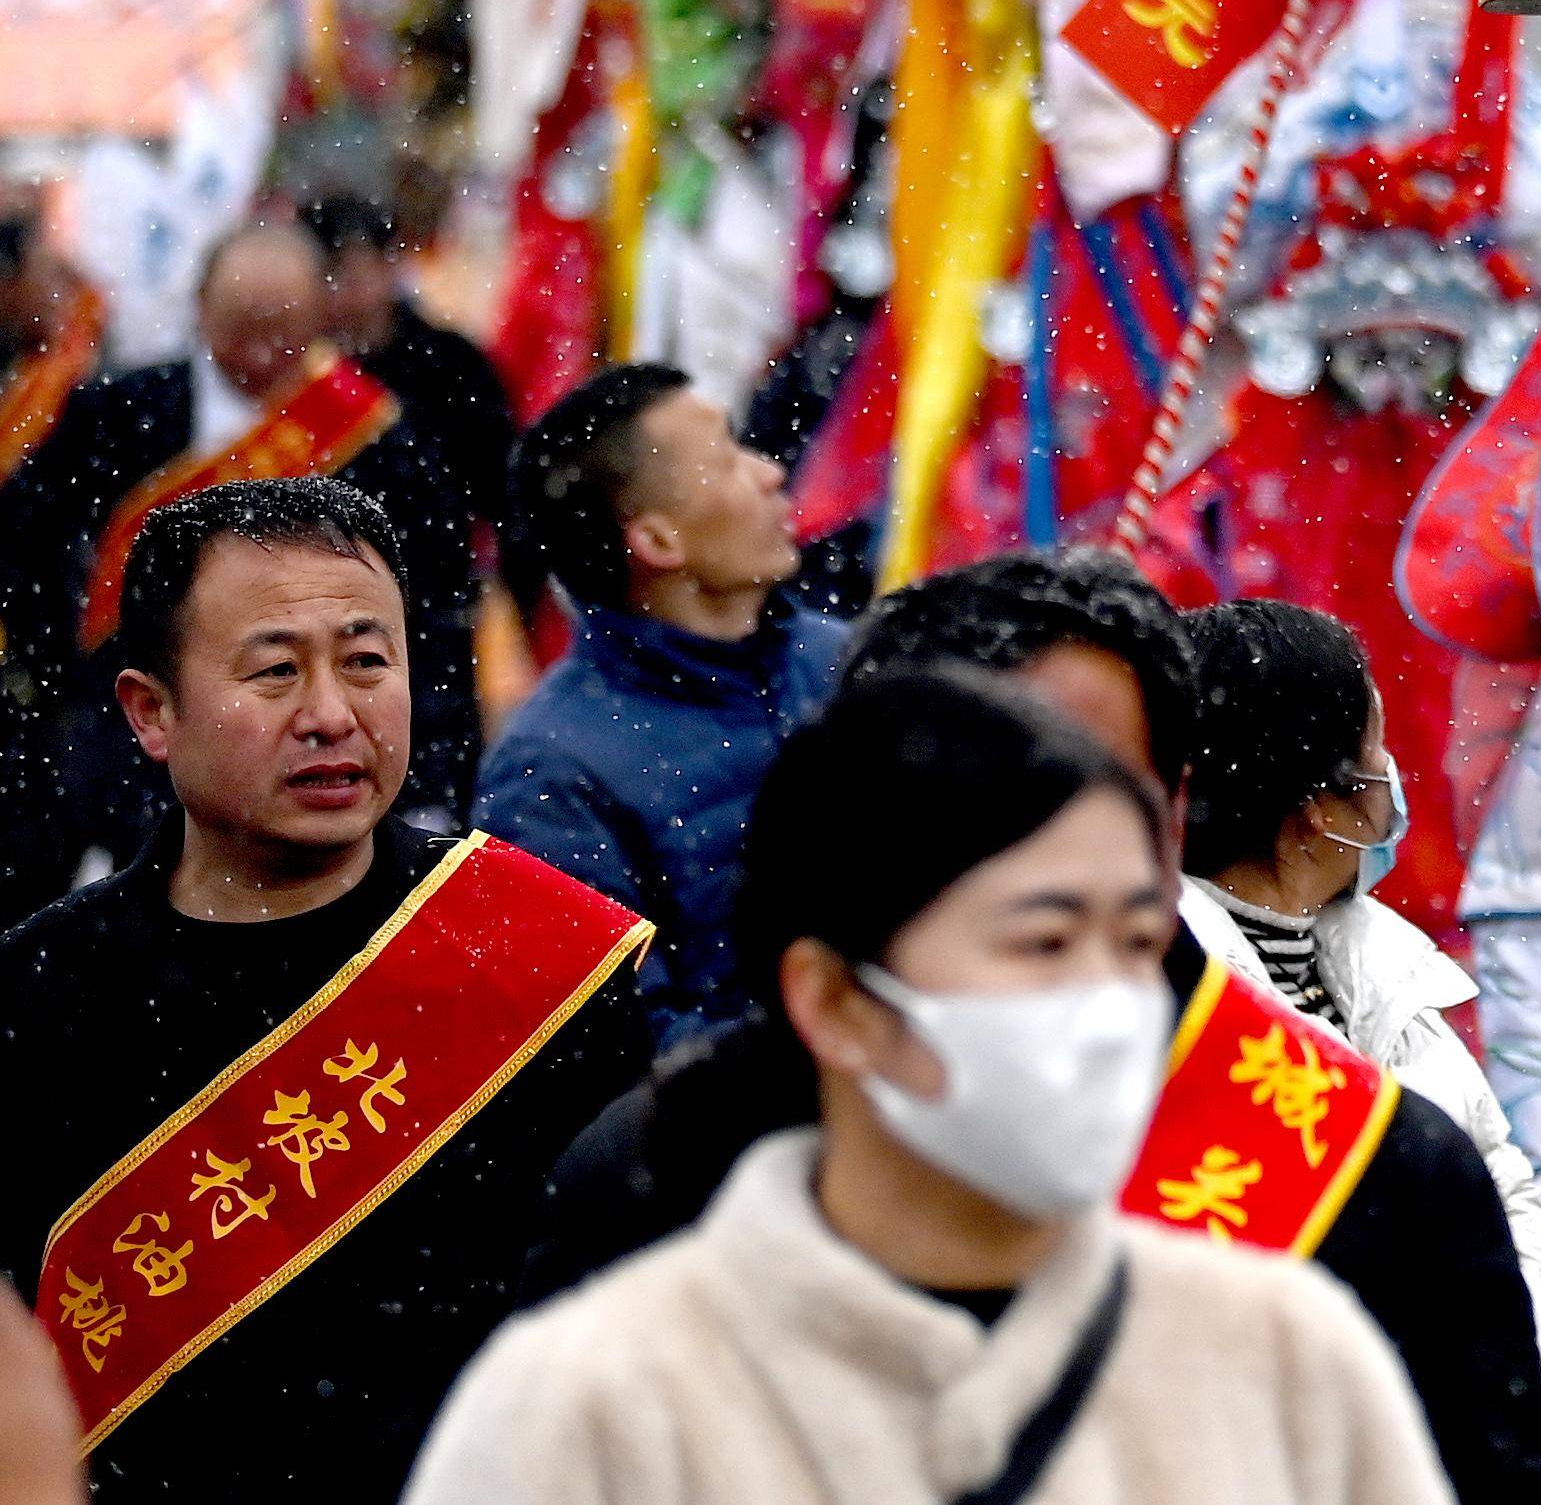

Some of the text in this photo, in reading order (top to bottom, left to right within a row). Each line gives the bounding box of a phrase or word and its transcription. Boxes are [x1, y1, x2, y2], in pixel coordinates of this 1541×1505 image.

[58, 1038, 407, 1373] 北坡村油桃
[1156, 1019, 1347, 1247] 城关
